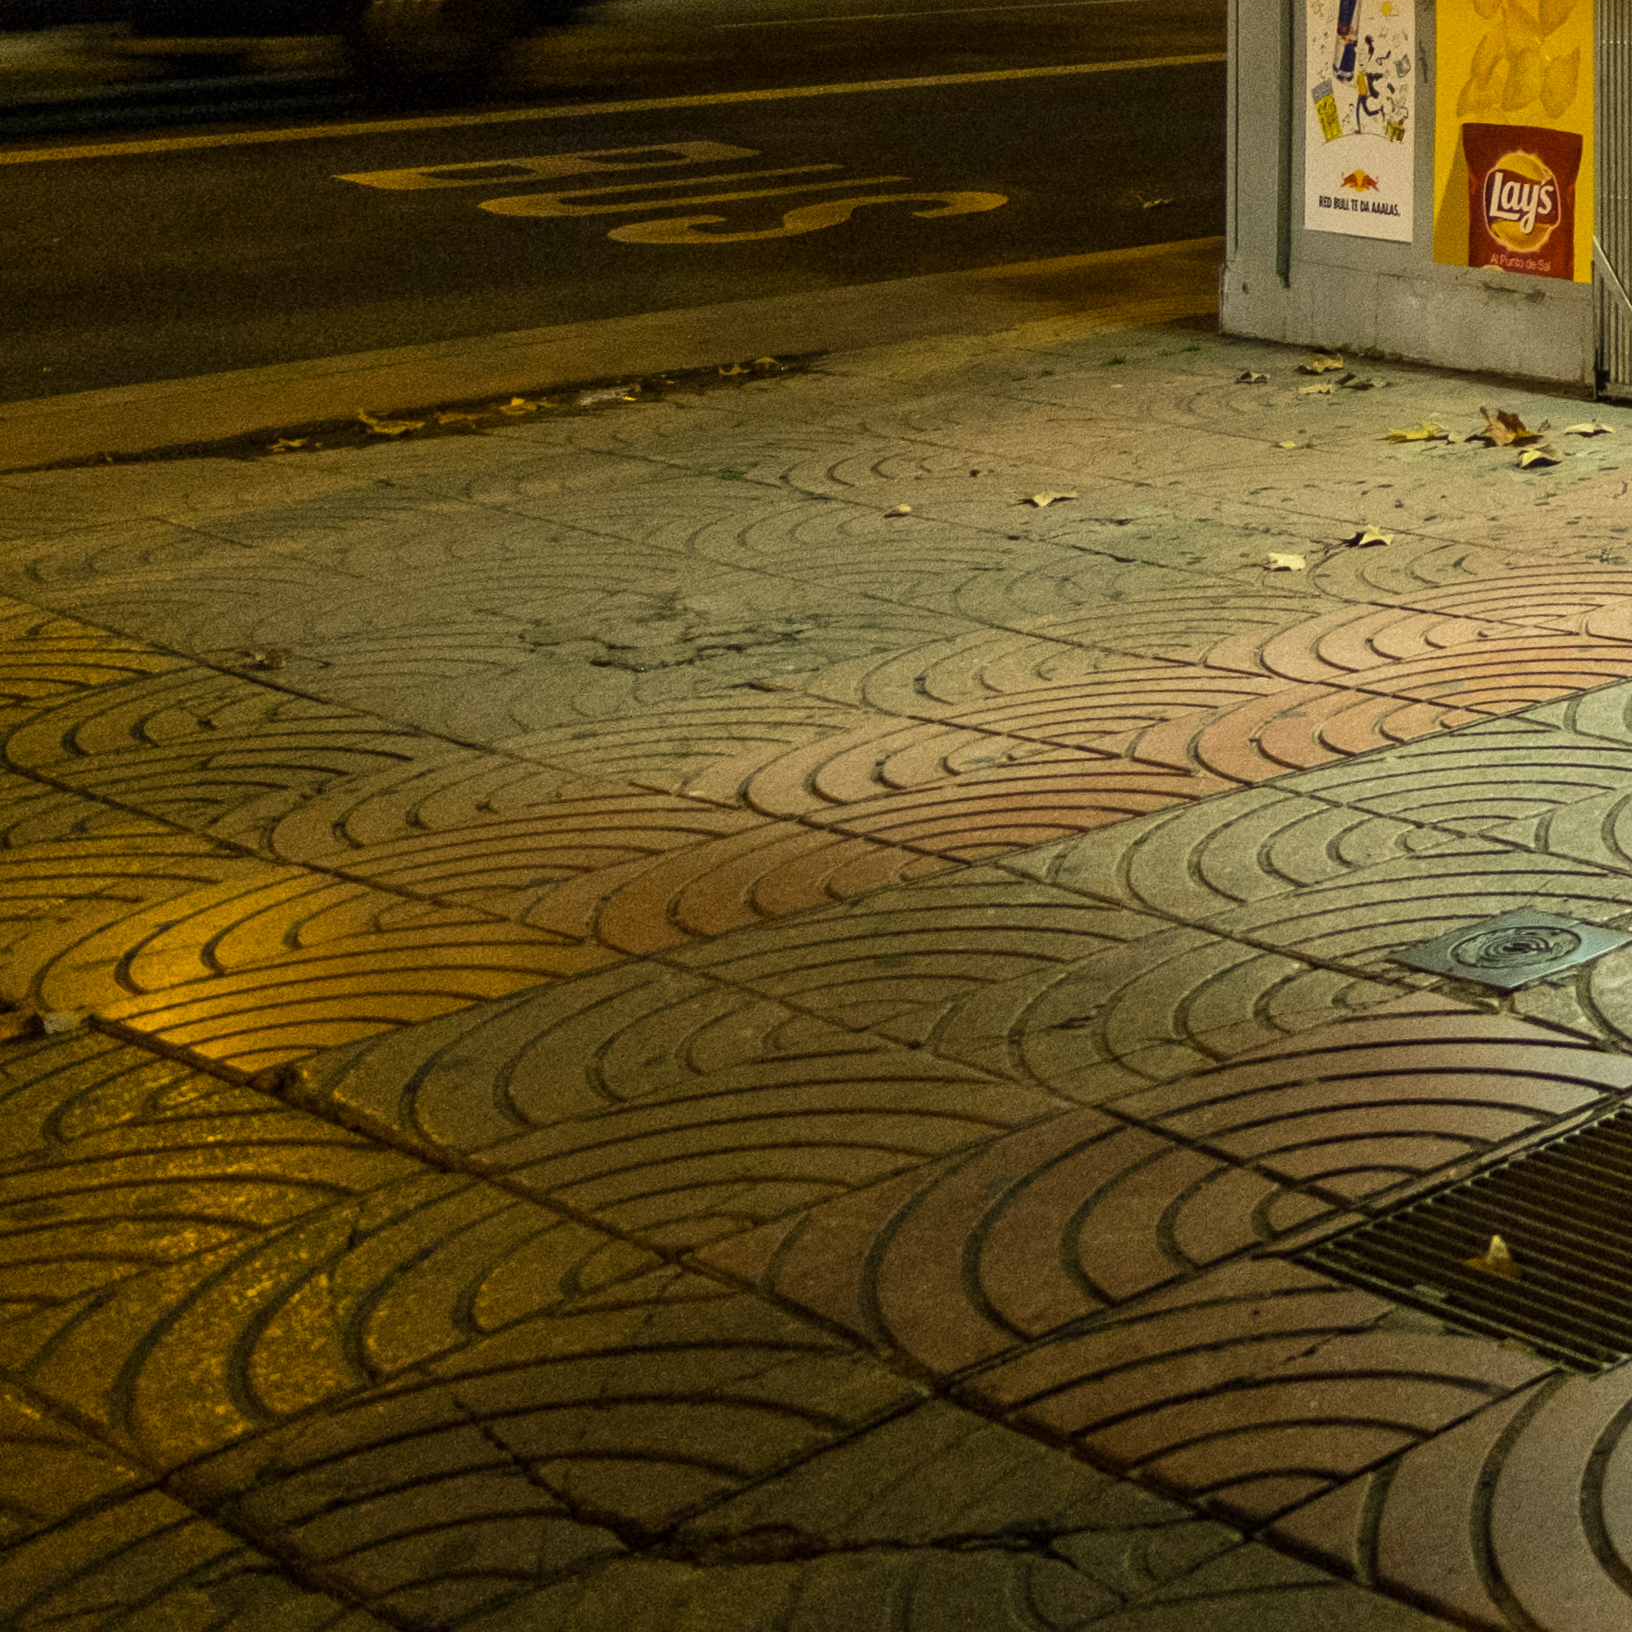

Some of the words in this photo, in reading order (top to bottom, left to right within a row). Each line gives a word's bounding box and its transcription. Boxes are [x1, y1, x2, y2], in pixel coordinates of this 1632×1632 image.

[1319, 195, 1332, 208] RED
[1333, 196, 1350, 211] BULL
[1360, 200, 1370, 213] DA
[1489, 171, 1555, 234] Lay's
[1501, 255, 1525, 269] Punto
[1525, 257, 1538, 268] de
